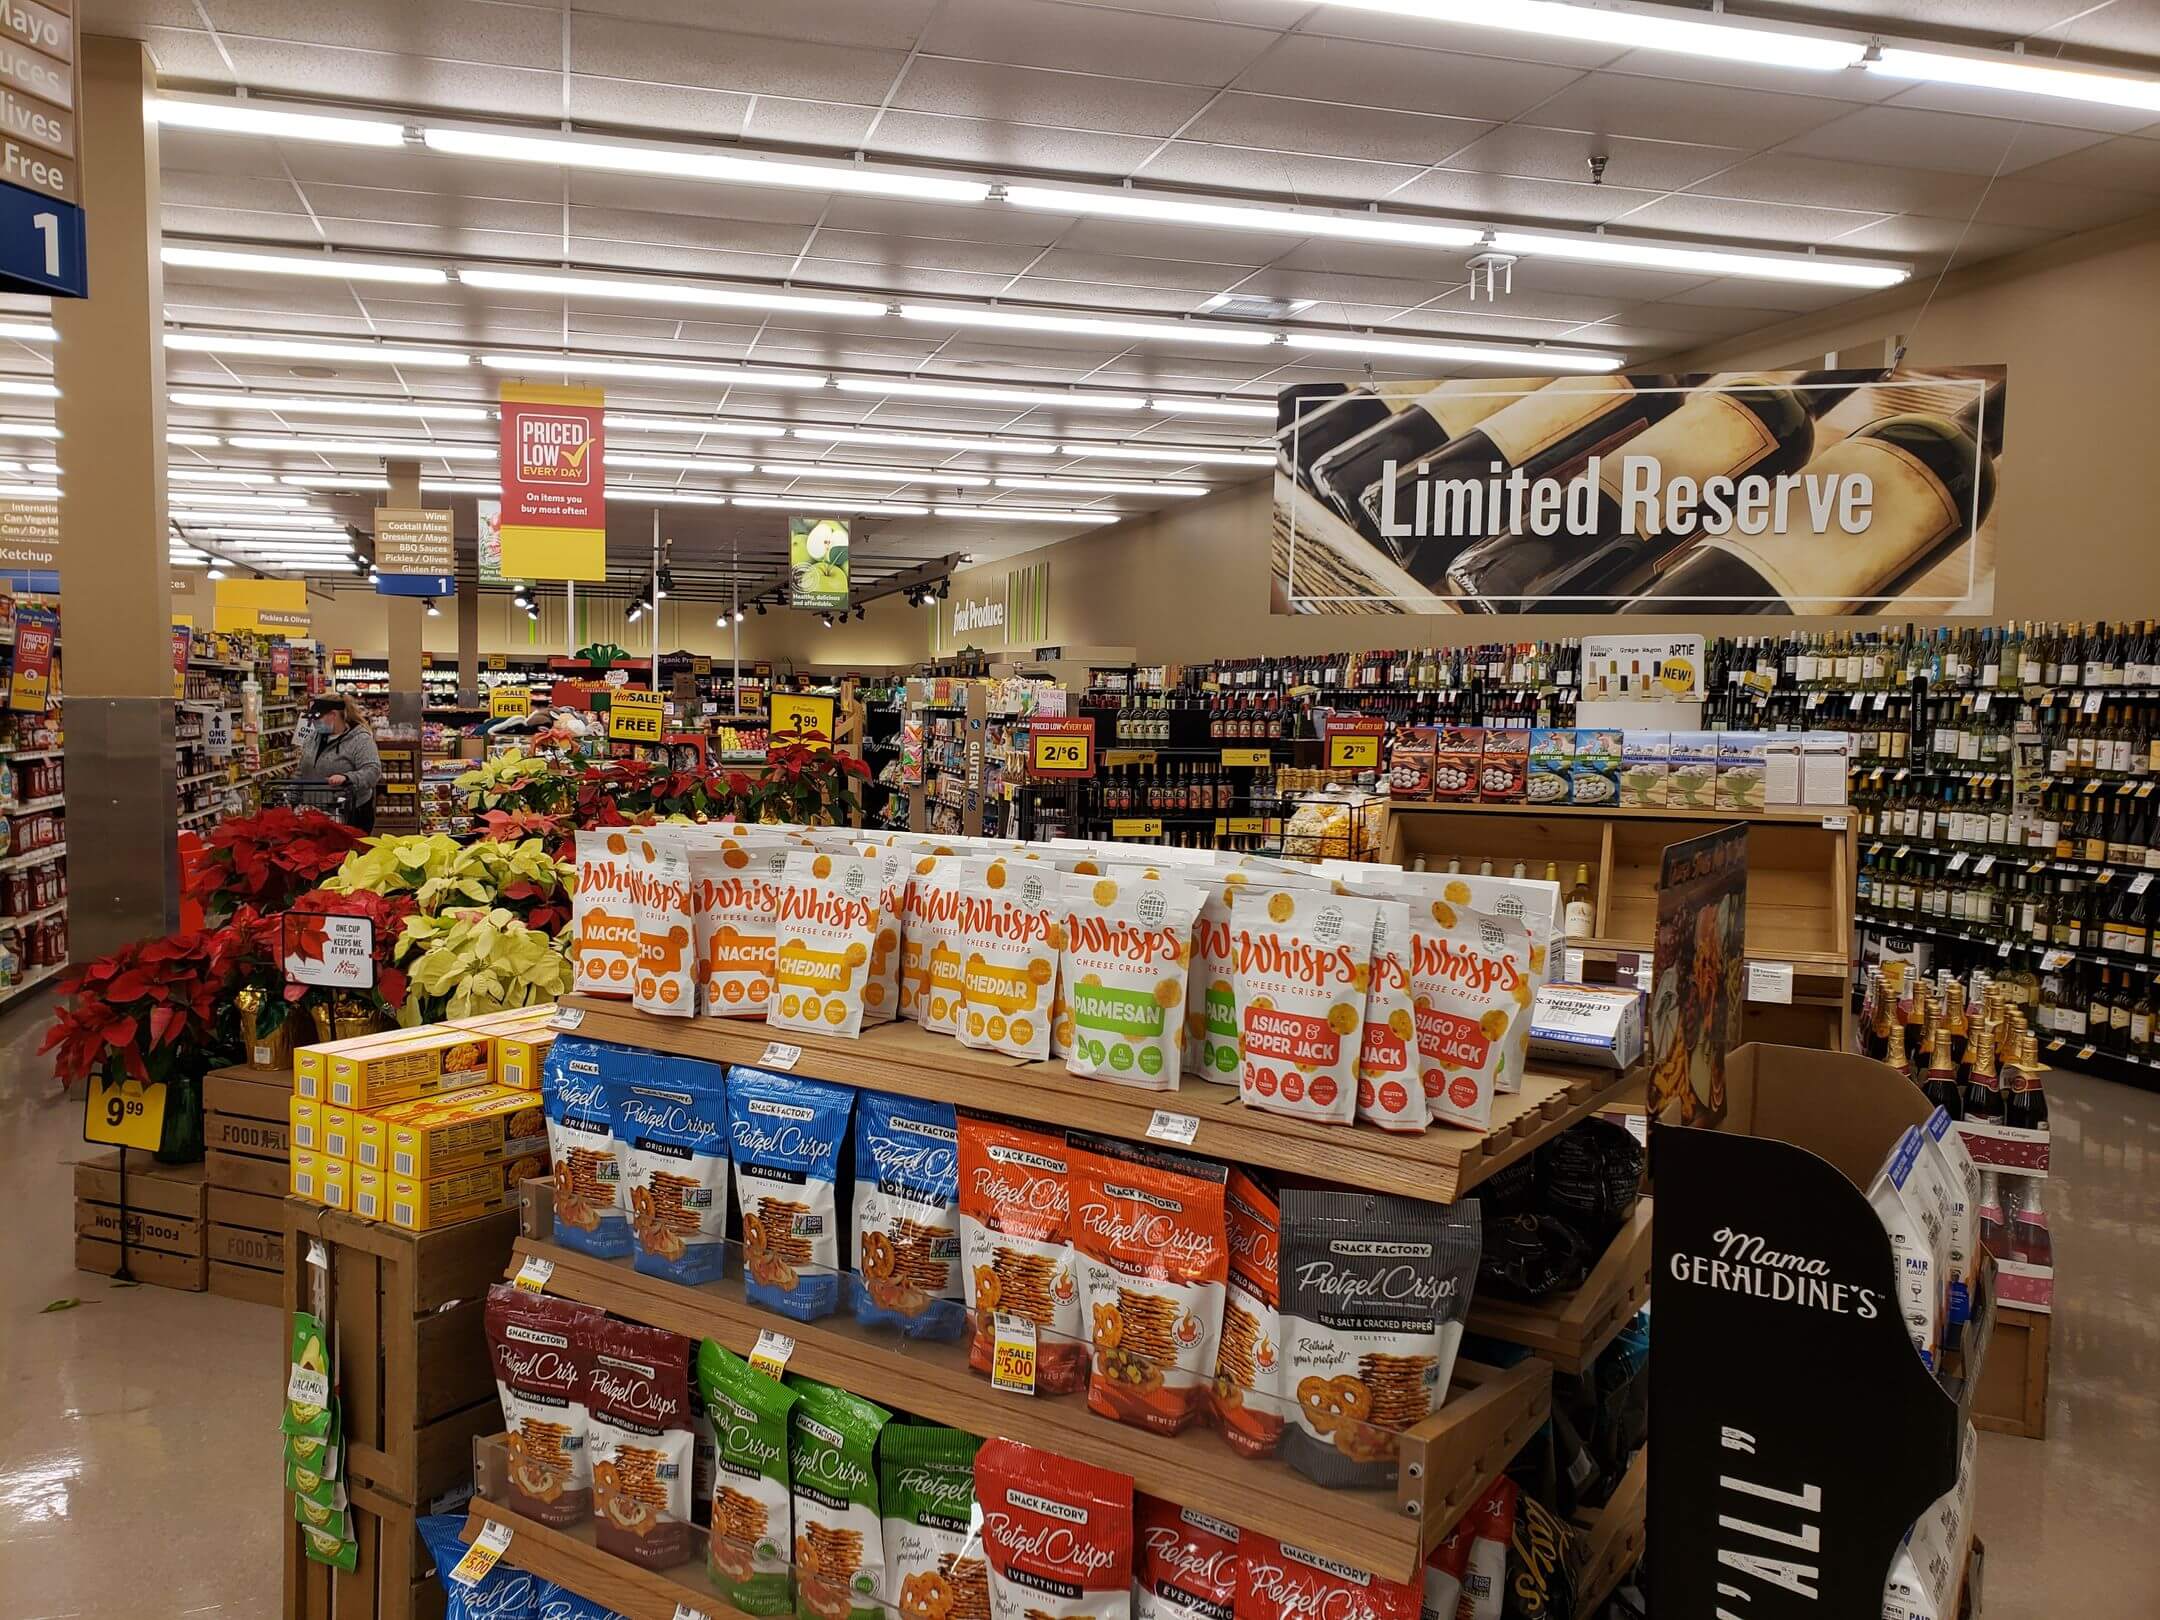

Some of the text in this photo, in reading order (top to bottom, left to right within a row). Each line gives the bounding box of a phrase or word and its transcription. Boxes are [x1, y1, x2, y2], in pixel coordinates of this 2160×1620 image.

[4, 142, 64, 191] Free
[33, 212, 60, 277] 1
[523, 421, 583, 445] PRICED
[523, 445, 560, 466] LOW
[523, 466, 582, 478] EVERY DAY
[527, 493, 582, 504] On items you
[1380, 455, 1873, 538] Limited Reserve
[4, 513, 21, 522] Can
[425, 512, 446, 520] Wine
[521, 504, 537, 515] buy
[562, 506, 588, 515] often!
[1, 525, 46, 536] Can Dry
[388, 522, 447, 531] Cocktail Mixes
[382, 533, 448, 543] Dressing Mayo
[0, 548, 53, 564] Ketchup
[400, 544, 418, 552] BBQ
[422, 555, 448, 563] Olives
[402, 565, 448, 574] Gluten Free
[438, 578, 447, 593] 1
[970, 596, 1003, 629] Produce
[22, 642, 37, 650] LOW
[23, 633, 48, 643] PRICED
[1669, 644, 1695, 656] ARTIE
[1663, 667, 1691, 682] NEW!
[630, 693, 661, 704] SALE!
[208, 730, 226, 738] ONE
[616, 720, 656, 732] FREE
[1032, 722, 1049, 730] PRICED
[1066, 722, 1082, 731] EVERY
[1083, 723, 1092, 731] DAY
[1328, 722, 1343, 730] PRICED
[208, 738, 227, 746] WAY
[969, 741, 980, 790] GLUTEN
[780, 886, 870, 928] Whisps
[710, 914, 747, 922] CHEESE
[959, 895, 1052, 944] Whisps
[336, 924, 360, 933] ONE CUP
[784, 925, 853, 939] CHEESE CRISPS
[334, 938, 352, 947] KEEPS
[966, 938, 1032, 954] CHEESE CRISPS
[1060, 912, 1181, 964] Whisps
[1888, 940, 1911, 951] VELLA
[339, 947, 348, 955] MY
[349, 948, 365, 956] PEAK
[718, 944, 776, 961] NACHO
[1233, 930, 1353, 986] Whisps
[780, 958, 841, 980] CHEDDAR
[1076, 958, 1159, 975] CHEESE CRISPS
[1410, 934, 1521, 993] Whisps
[966, 972, 1028, 999] CHEDDAR
[1246, 979, 1332, 999] CHEESE CRISPS
[1413, 979, 1491, 1005] CHEESE CRISPS
[1075, 996, 1160, 1024] PARMESAN
[1251, 1015, 1320, 1040] ASIAGO &
[1456, 1024, 1471, 1040] &
[1245, 1031, 1334, 1061] PEPPER JACK
[1440, 1041, 1481, 1063] JACK
[1364, 1047, 1401, 1066] JACK
[750, 1103, 812, 1120] SNACK FACTORY
[564, 1119, 601, 1132] ORIGINAL
[891, 1118, 921, 1133] SNACK
[223, 1124, 259, 1146] FOOD
[731, 1120, 832, 1165] Pretzel Crisps
[645, 1141, 684, 1156] ORIGINAL
[1025, 1155, 1066, 1172] FACTORY
[752, 1167, 792, 1181] ORIGINAL
[1106, 1184, 1180, 1210] SNACK FACTORY
[1079, 1202, 1214, 1266] Pretzel Crisps
[227, 1238, 262, 1259] FOOD
[1333, 1241, 1430, 1256] SNACK FACTORY
[1713, 1226, 1831, 1278] Mama
[1145, 1266, 1169, 1278] WING
[1906, 1258, 1928, 1271] PAIR
[1908, 1267, 1926, 1277] with
[1296, 1261, 1457, 1311] Pretzel Crisps
[1670, 1252, 1878, 1320] GERALDINE'S
[1320, 1315, 1433, 1332] SEA SALT & CRACKED PEPPER
[508, 1328, 567, 1346] SNACK FACTORY
[1298, 1338, 1335, 1353] Rethink
[1009, 1348, 1034, 1361] SALE!
[1294, 1352, 1348, 1368] your pretzel!
[760, 1361, 782, 1375] SALE!
[613, 1416, 635, 1431] MUSTARD
[729, 1425, 780, 1466] Crisps
[819, 1449, 868, 1488] Crisps
[814, 1490, 847, 1508] PARMESAN
[1008, 1492, 1086, 1521] SNACK FACTORY
[919, 1514, 951, 1528] GARLIC
[986, 1512, 1114, 1578] Pretzel Crisps
[1145, 1527, 1212, 1582] Pretzel
[1282, 1546, 1369, 1581] SNACK FACTORY
[1007, 1568, 1075, 1596] EVERYTHING
